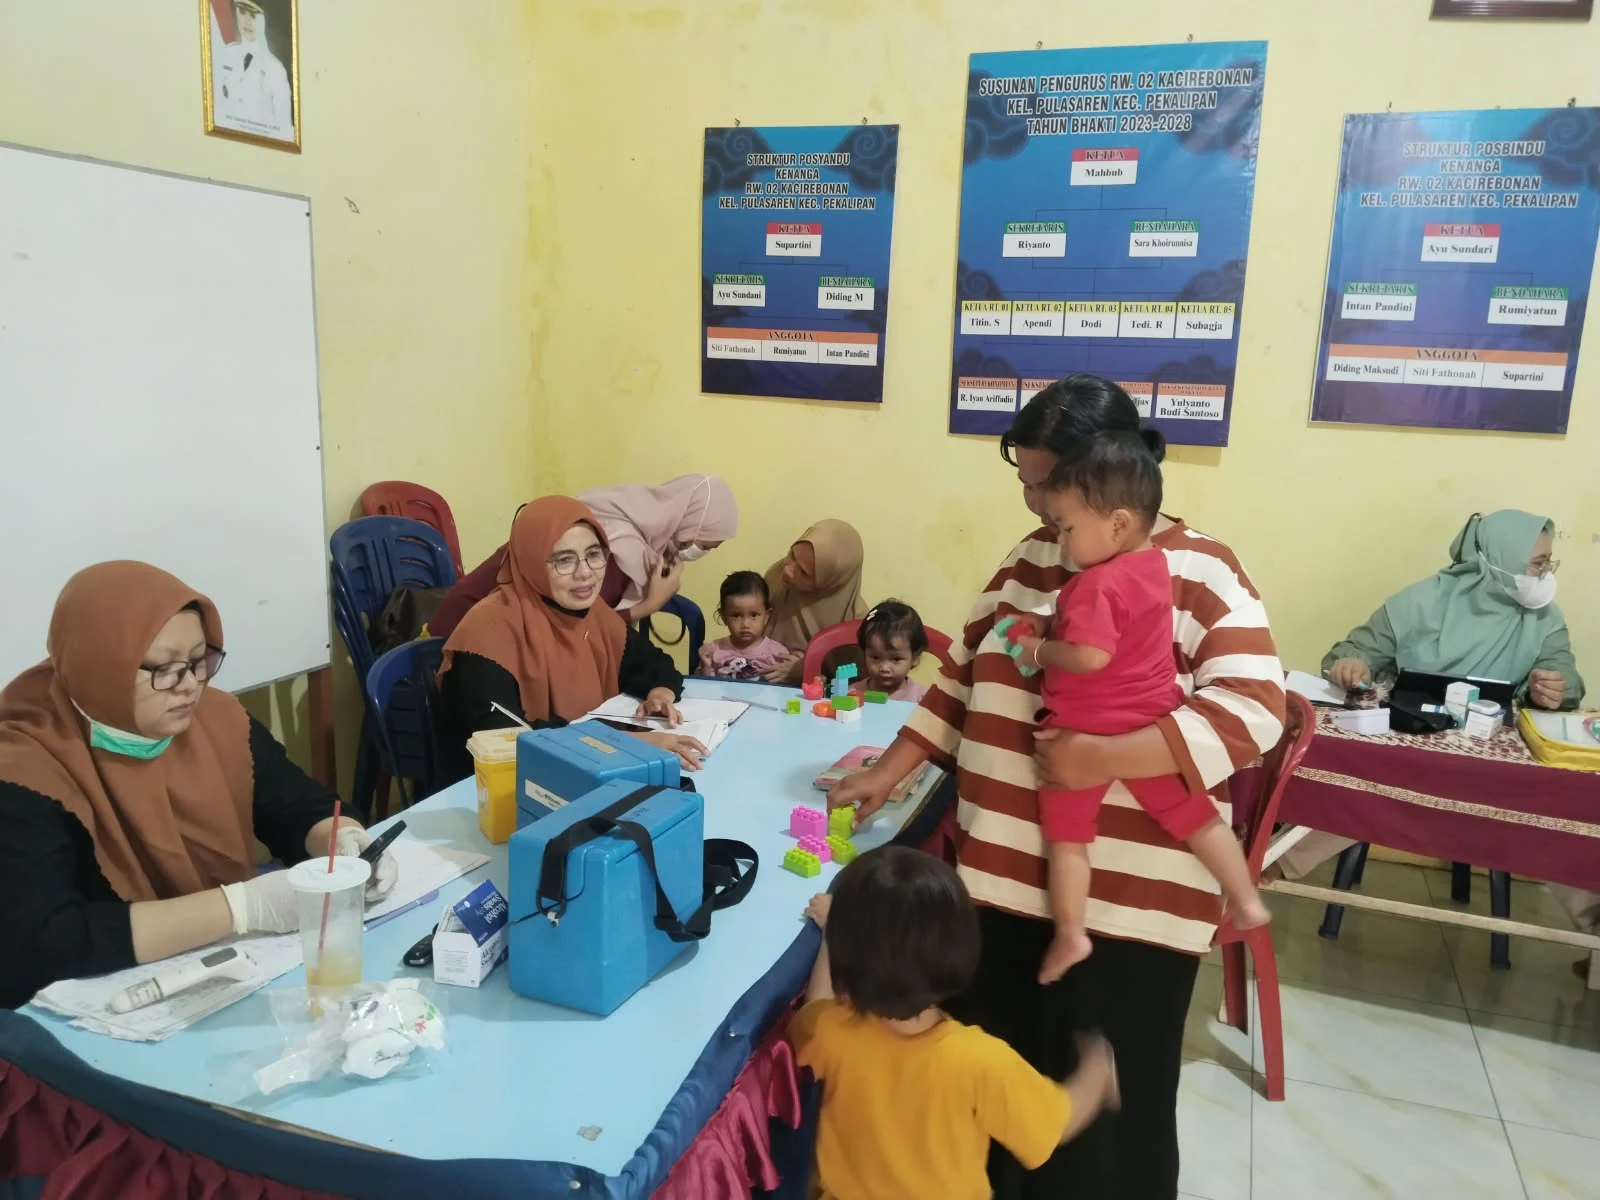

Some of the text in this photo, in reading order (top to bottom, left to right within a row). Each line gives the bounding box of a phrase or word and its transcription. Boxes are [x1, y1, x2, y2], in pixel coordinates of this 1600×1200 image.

[980, 68, 1252, 96] SUSUNAN PENGURUS RW. 02 KACIREBONAN
[1007, 91, 1217, 115] KEL. PULASAREN KEC. PEKALIPAN
[1027, 114, 1192, 136] TAHUN BHAKTI 2023-2028
[1404, 141, 1546, 157] STRUKTUR POSBINDU
[747, 153, 851, 166] STRUKTUR POSYANDU
[1086, 151, 1124, 160] KETUA
[1440, 159, 1501, 174] KENANGA
[775, 168, 820, 180] KENANGA
[1085, 168, 1123, 177] Mahbub
[745, 182, 849, 195] RW. 02 KACIREBONAN
[1399, 176, 1542, 191] RW. 02 KACIREBONAN
[719, 197, 877, 210] KEL. PULASAREN KEC. PEKALIPAN
[1360, 193, 1579, 209] KEL. PULASAREN KEC. PEKALIPAN
[778, 224, 811, 233] KETUA
[775, 240, 812, 251] Supartini
[1018, 240, 1051, 251] Riyanto
[1134, 238, 1193, 248] Sara Khoirunnisa
[1428, 244, 1494, 256] Ayu Sundari
[718, 290, 731, 300] Ayu
[826, 292, 864, 303] Diding M
[964, 303, 988, 312] KETUA
[1001, 303, 1009, 312] 01
[1015, 303, 1040, 312] KETUA
[1053, 303, 1062, 312] 02
[1069, 304, 1093, 313] KETUA
[1108, 304, 1117, 313] 03
[1124, 304, 1149, 313] KETUA
[1165, 304, 1173, 313] 04
[1180, 304, 1207, 313] KETUA
[1223, 305, 1233, 314] 05
[1346, 301, 1413, 312] Intan Pandini
[1498, 304, 1558, 317] Rumiyatun
[970, 318, 1001, 327] Titin. S
[1023, 319, 1052, 329] Apendi
[1081, 320, 1102, 329] Dodi
[1131, 320, 1163, 329] Tedi. R
[1185, 321, 1223, 332] Subagja
[768, 332, 814, 341] ANGGOTA
[711, 344, 724, 353] Siti
[773, 346, 807, 357] Rumiyatun
[826, 348, 843, 358] Intan
[1415, 350, 1479, 361] ANGGOTA
[1333, 363, 1400, 375] Diding Maksudi
[1413, 367, 1477, 379] Siti Fathonah
[1503, 371, 1545, 383] Supartini
[960, 393, 968, 402] R.
[986, 395, 1014, 404] Ariffudin
[1160, 407, 1220, 418] Budi Santoso
[483, 893, 502, 911] Swabs
[484, 901, 508, 924] Alcohol
